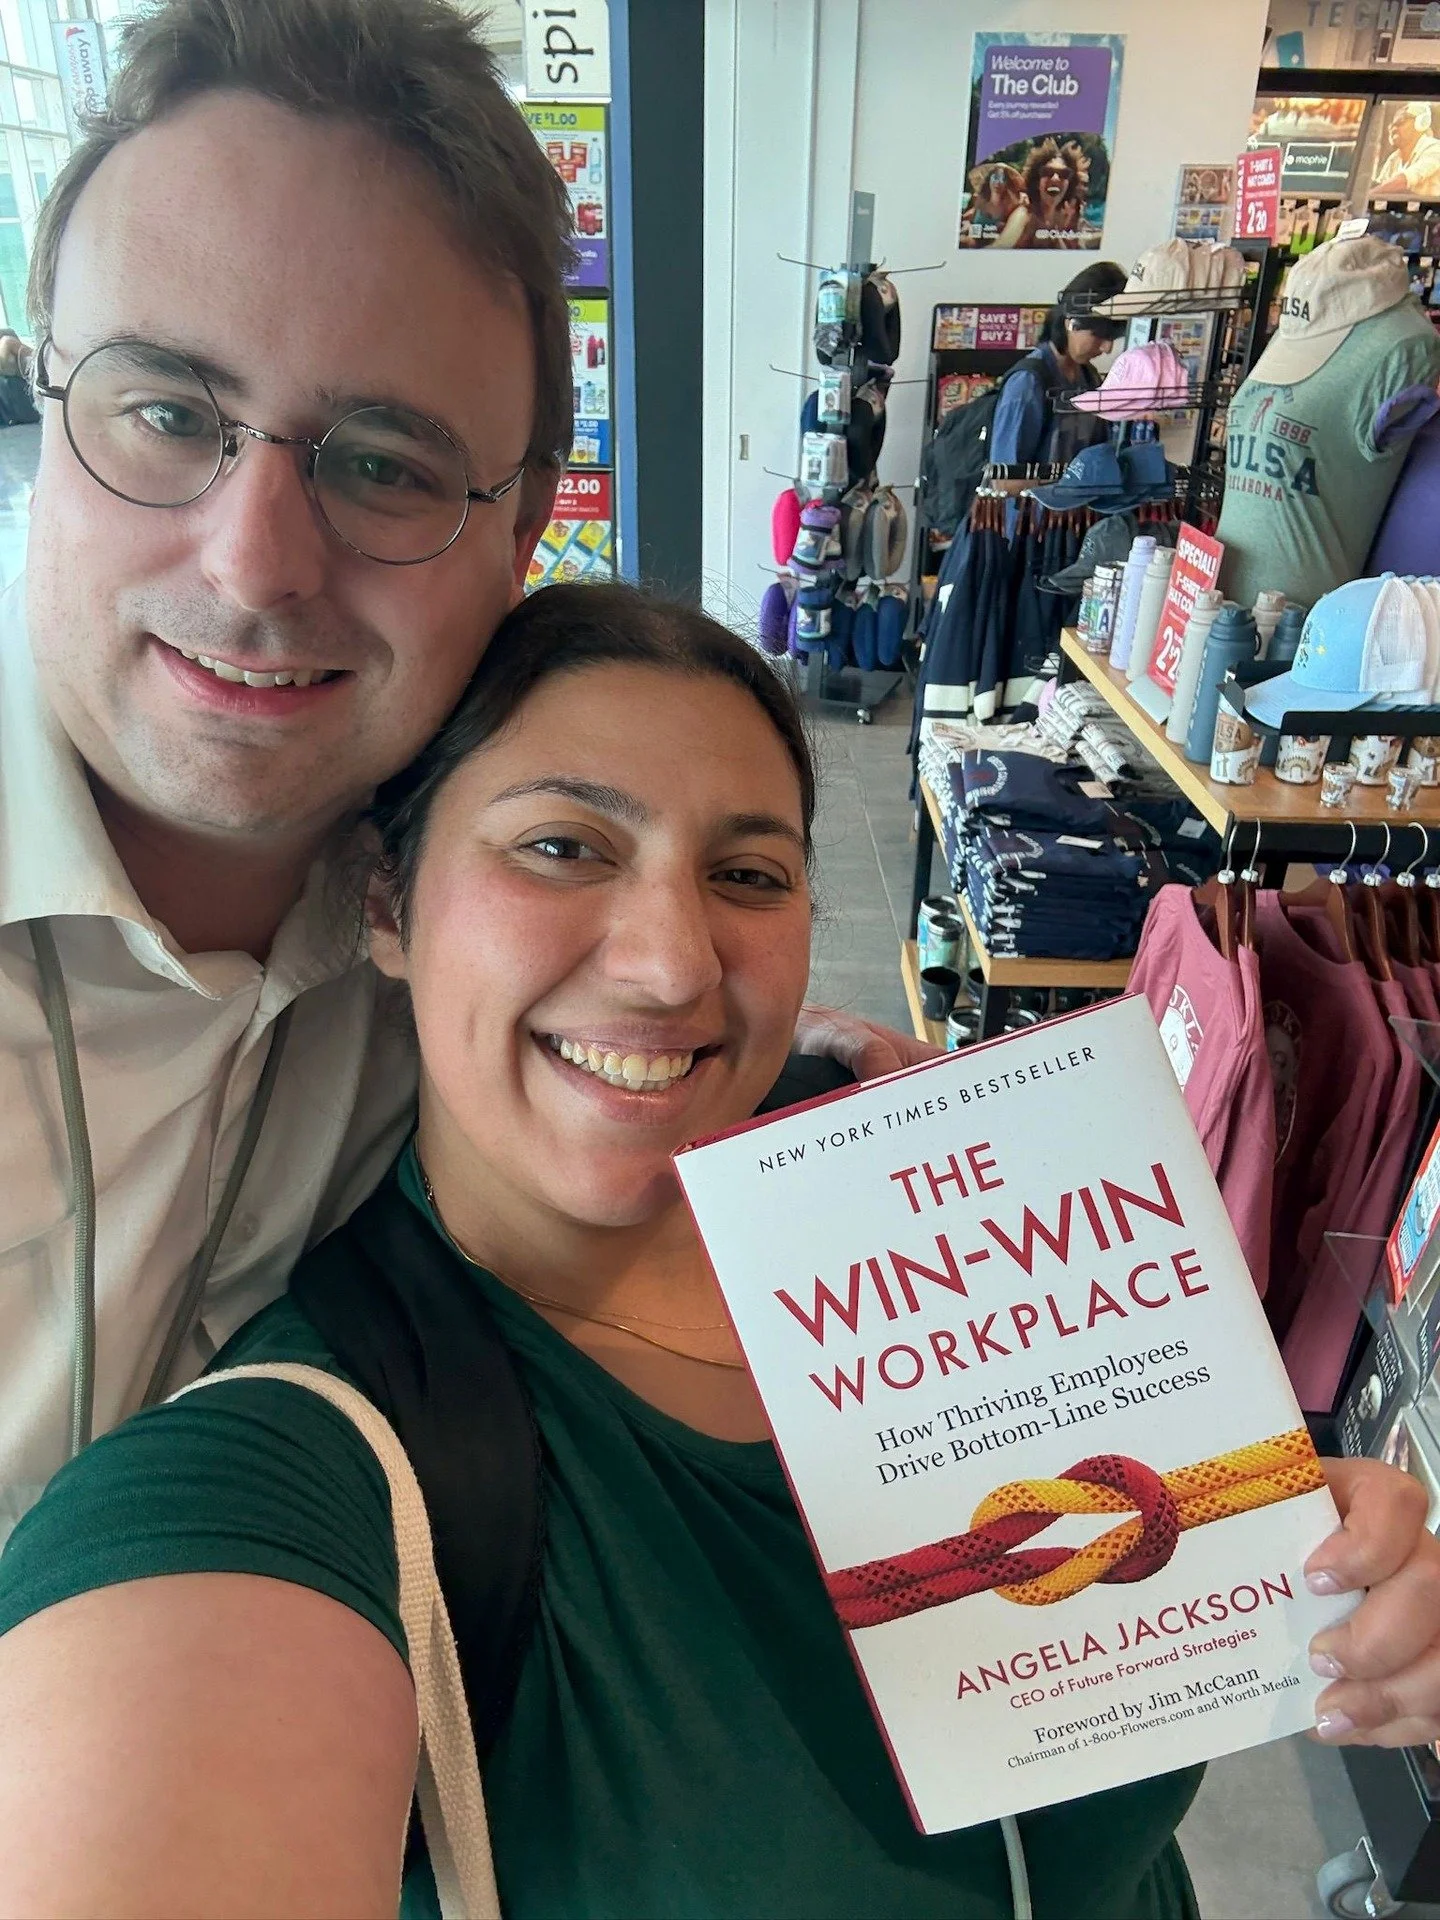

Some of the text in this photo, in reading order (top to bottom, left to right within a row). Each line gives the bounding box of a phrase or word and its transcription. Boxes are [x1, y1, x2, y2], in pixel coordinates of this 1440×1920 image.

[532, 8, 594, 84] spi
[1306, 2, 1399, 30] TECH
[78, 38, 93, 84] away
[990, 54, 1070, 71] Welcome to
[990, 73, 1079, 96] The Club
[1295, 155, 1328, 166] mophie
[1247, 202, 1256, 234] 2
[980, 313, 1007, 324] SAVE
[981, 331, 1013, 341] BUY 2
[556, 478, 600, 495] $2.00
[1229, 433, 1320, 496] ULSA
[1178, 537, 1218, 577] SPECIAL!
[1156, 625, 1174, 672] 2
[759, 1046, 1096, 1174] NEW YORK TIMES BESTSELLER
[889, 1142, 1004, 1214] THE
[774, 1163, 1186, 1347] WIN-WIN
[809, 1248, 1210, 1413] WORKPLACE
[875, 1336, 1189, 1453] How Thriving Employees
[875, 1365, 1211, 1485] Drive Bottom-Line Success
[956, 1572, 1295, 1700] ANGELA JACKSON
[1010, 1625, 1258, 1710] CEO of Future Forward Strategies
[1007, 1673, 1301, 1769] Chairman of 1-800-Flowers.com and Worth Media
[1033, 1664, 1261, 1745] Foreword by Jim McCann
